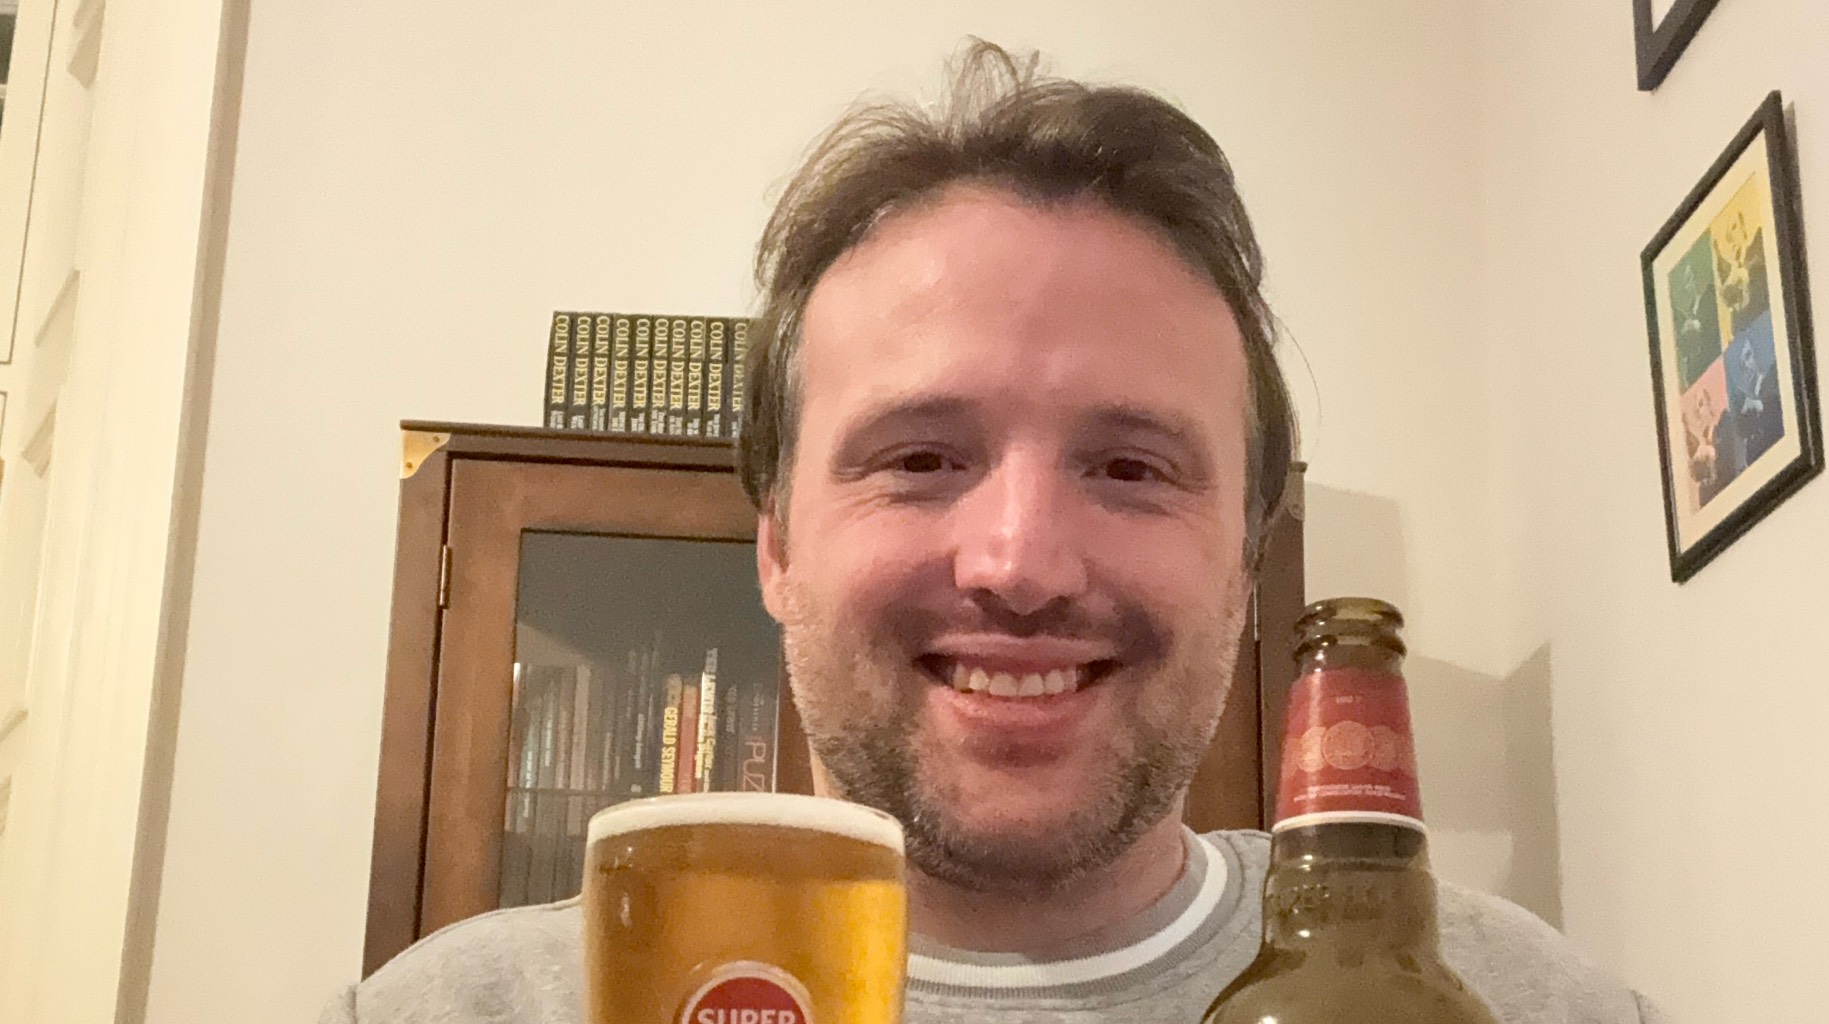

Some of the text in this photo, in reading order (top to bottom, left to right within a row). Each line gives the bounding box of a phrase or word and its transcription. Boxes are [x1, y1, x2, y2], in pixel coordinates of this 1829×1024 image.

[555, 315, 569, 352] COLIN
[576, 316, 590, 354] COLIN
[596, 316, 610, 354] COLIN
[616, 319, 629, 357] COLIN
[636, 319, 650, 357] COLIN
[654, 319, 668, 357] COLIN
[672, 320, 686, 358] COLIN
[690, 321, 703, 358] COLIN
[710, 322, 723, 360] COLIN
[734, 323, 746, 360] COLIN
[552, 356, 567, 404] DEXTER
[572, 358, 589, 405] DEXTER
[592, 357, 608, 405] DEXTER
[613, 360, 628, 408] DEXTER
[633, 360, 648, 408] DEXTER
[652, 360, 667, 408] DEXTER
[670, 362, 684, 410] DEXTER
[688, 362, 701, 410] DEXTER
[708, 364, 722, 411] DEXTER
[660, 707, 678, 793] GERALD SEYMOUR
